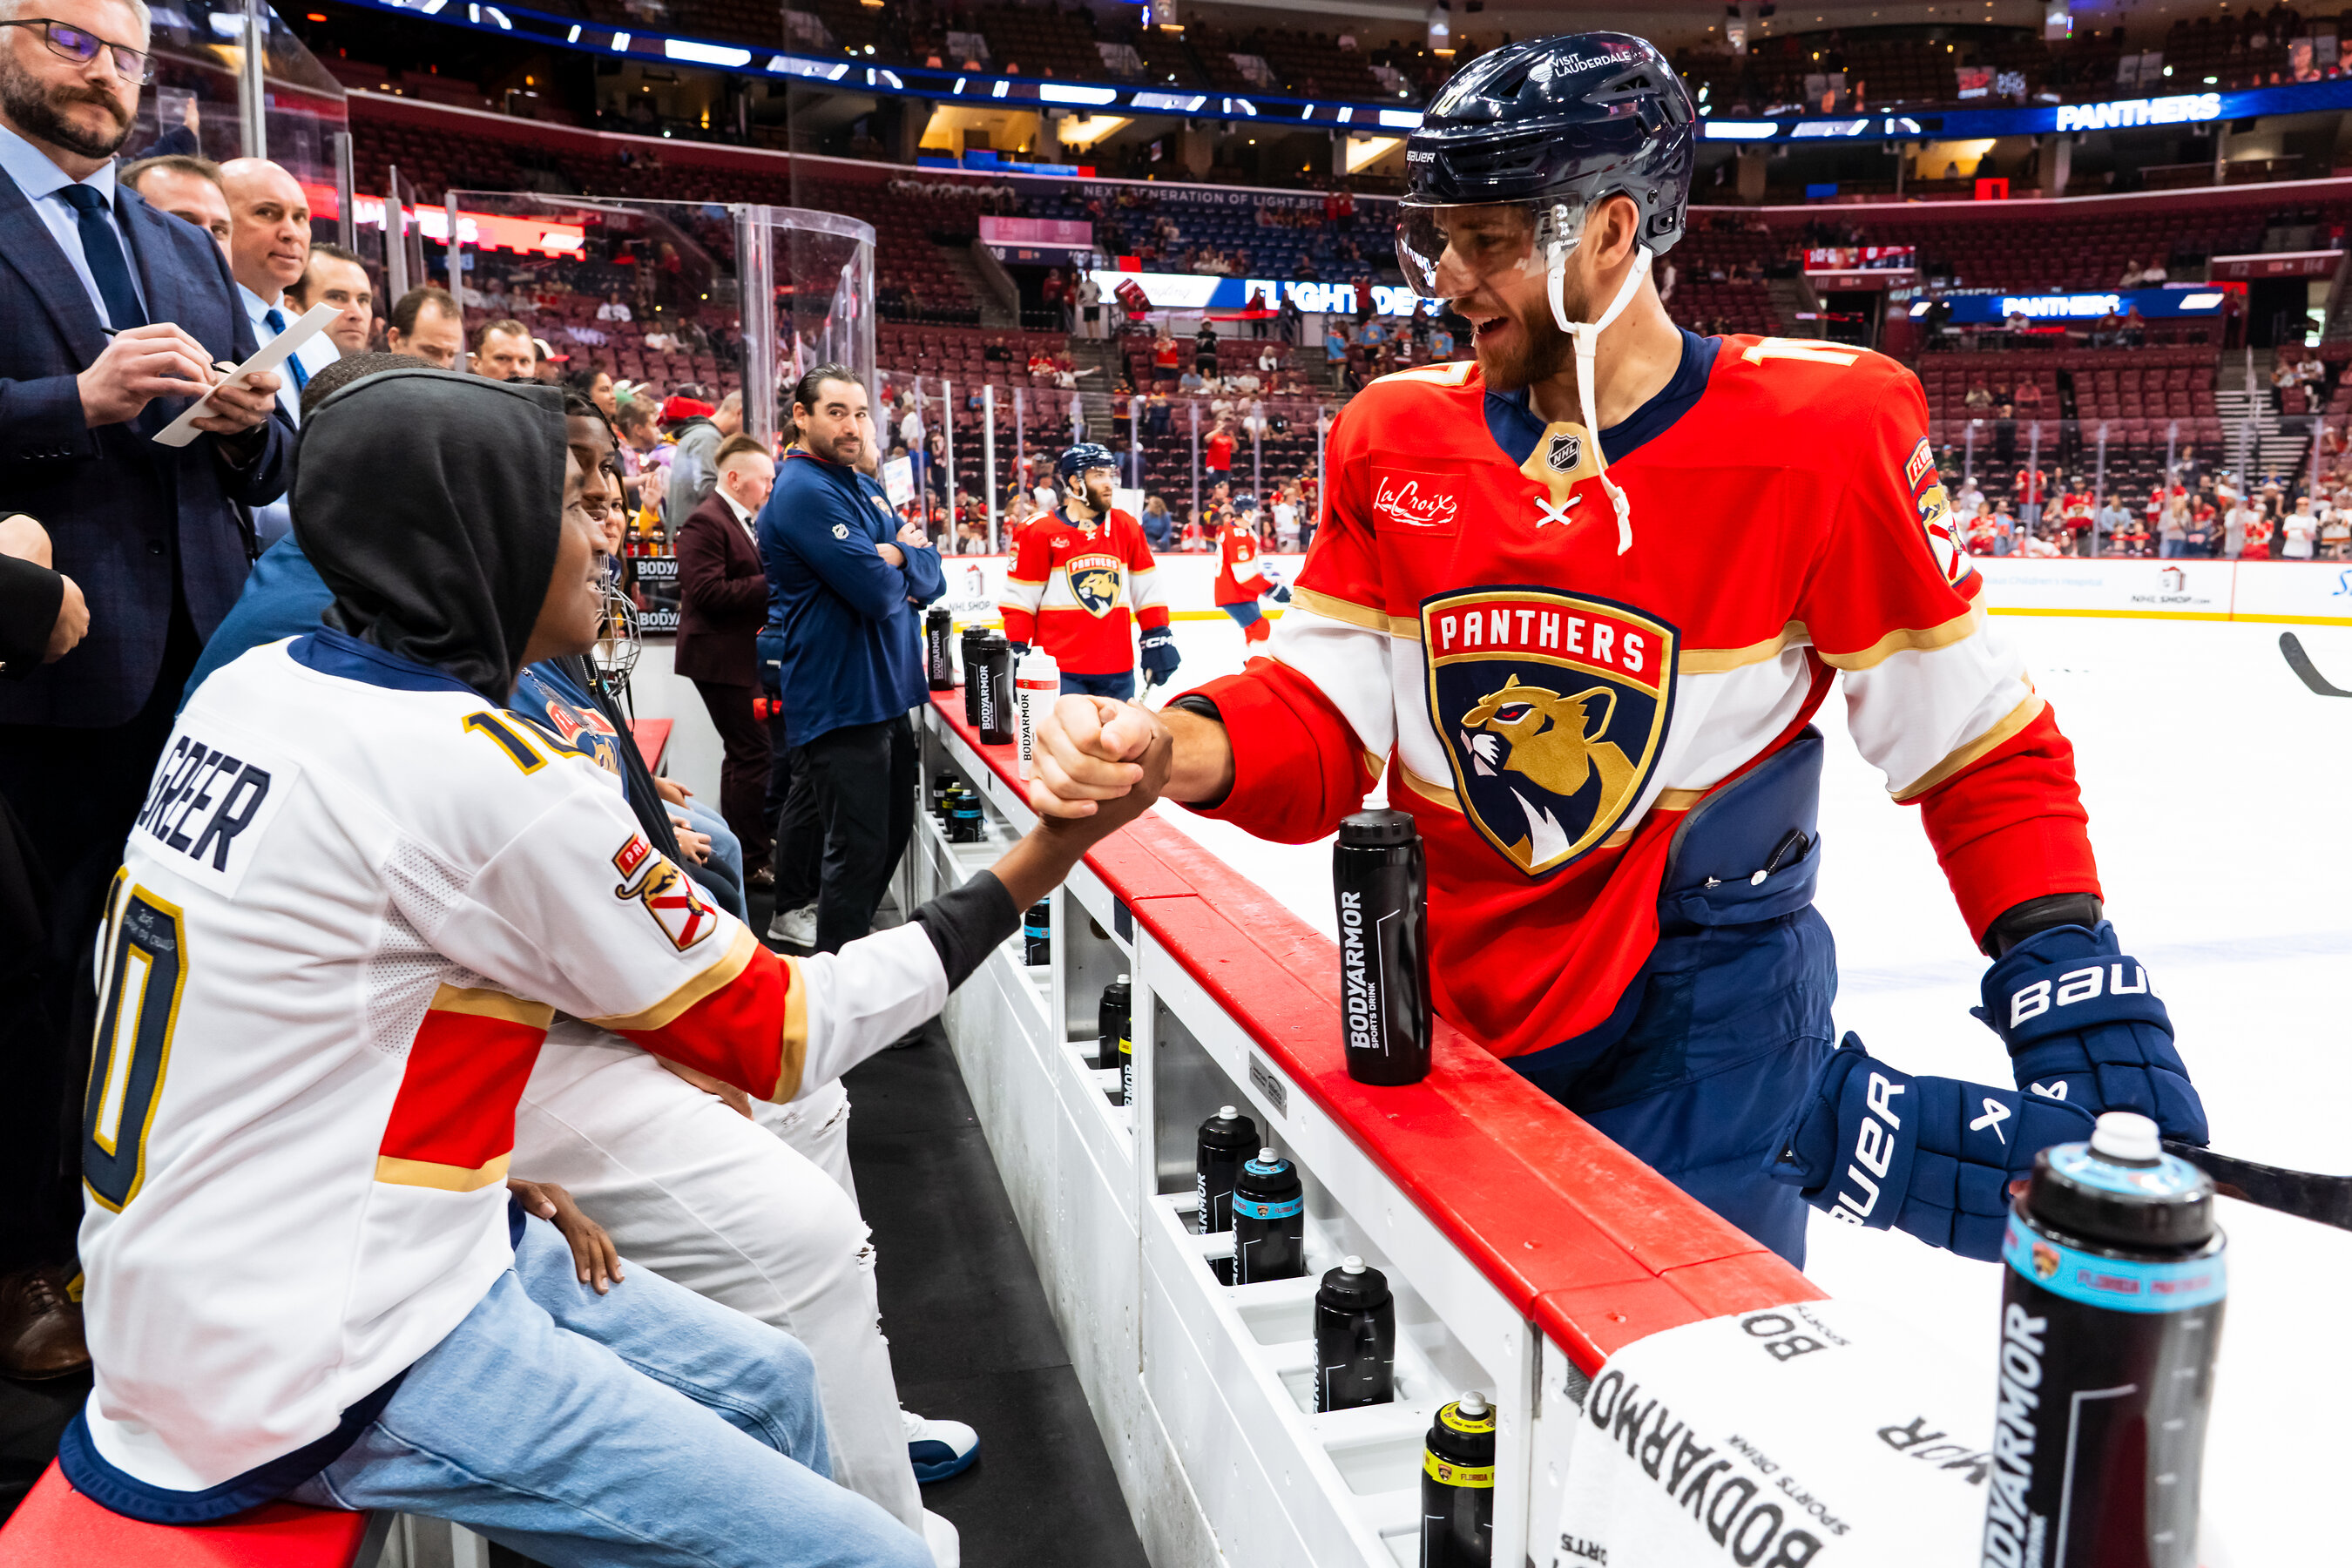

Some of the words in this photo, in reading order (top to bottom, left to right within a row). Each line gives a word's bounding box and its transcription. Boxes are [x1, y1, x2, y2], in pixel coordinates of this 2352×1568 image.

[1551, 53, 1579, 68] VISIT
[1555, 51, 1632, 78] LAUDERDALE
[2056, 92, 2221, 132] PANTHERS
[1229, 193, 1247, 205] OF
[1253, 196, 1294, 208] LIGHT
[2002, 294, 2120, 317] PANTHERS
[1553, 444, 1576, 465] NHL
[1374, 476, 1457, 518] LaCroix
[1071, 557, 1118, 571] PANTHERS
[931, 630, 942, 680] BODYARMOR
[1440, 609, 1645, 672] PANTHERS
[979, 665, 990, 730] BODYARMOR
[1021, 693, 1032, 761] BODYARMOR
[138, 734, 271, 873] GREER
[1342, 891, 1371, 1049] BODYARMOR
[1367, 981, 1376, 1010] DRINK
[2010, 963, 2161, 1030] BAU
[1370, 1012, 1380, 1049] SPORTS
[1727, 1434, 1781, 1475] DRINK
[1982, 1302, 2048, 1568] DYARMOR
[1774, 1476, 1852, 1537] SPORTS
